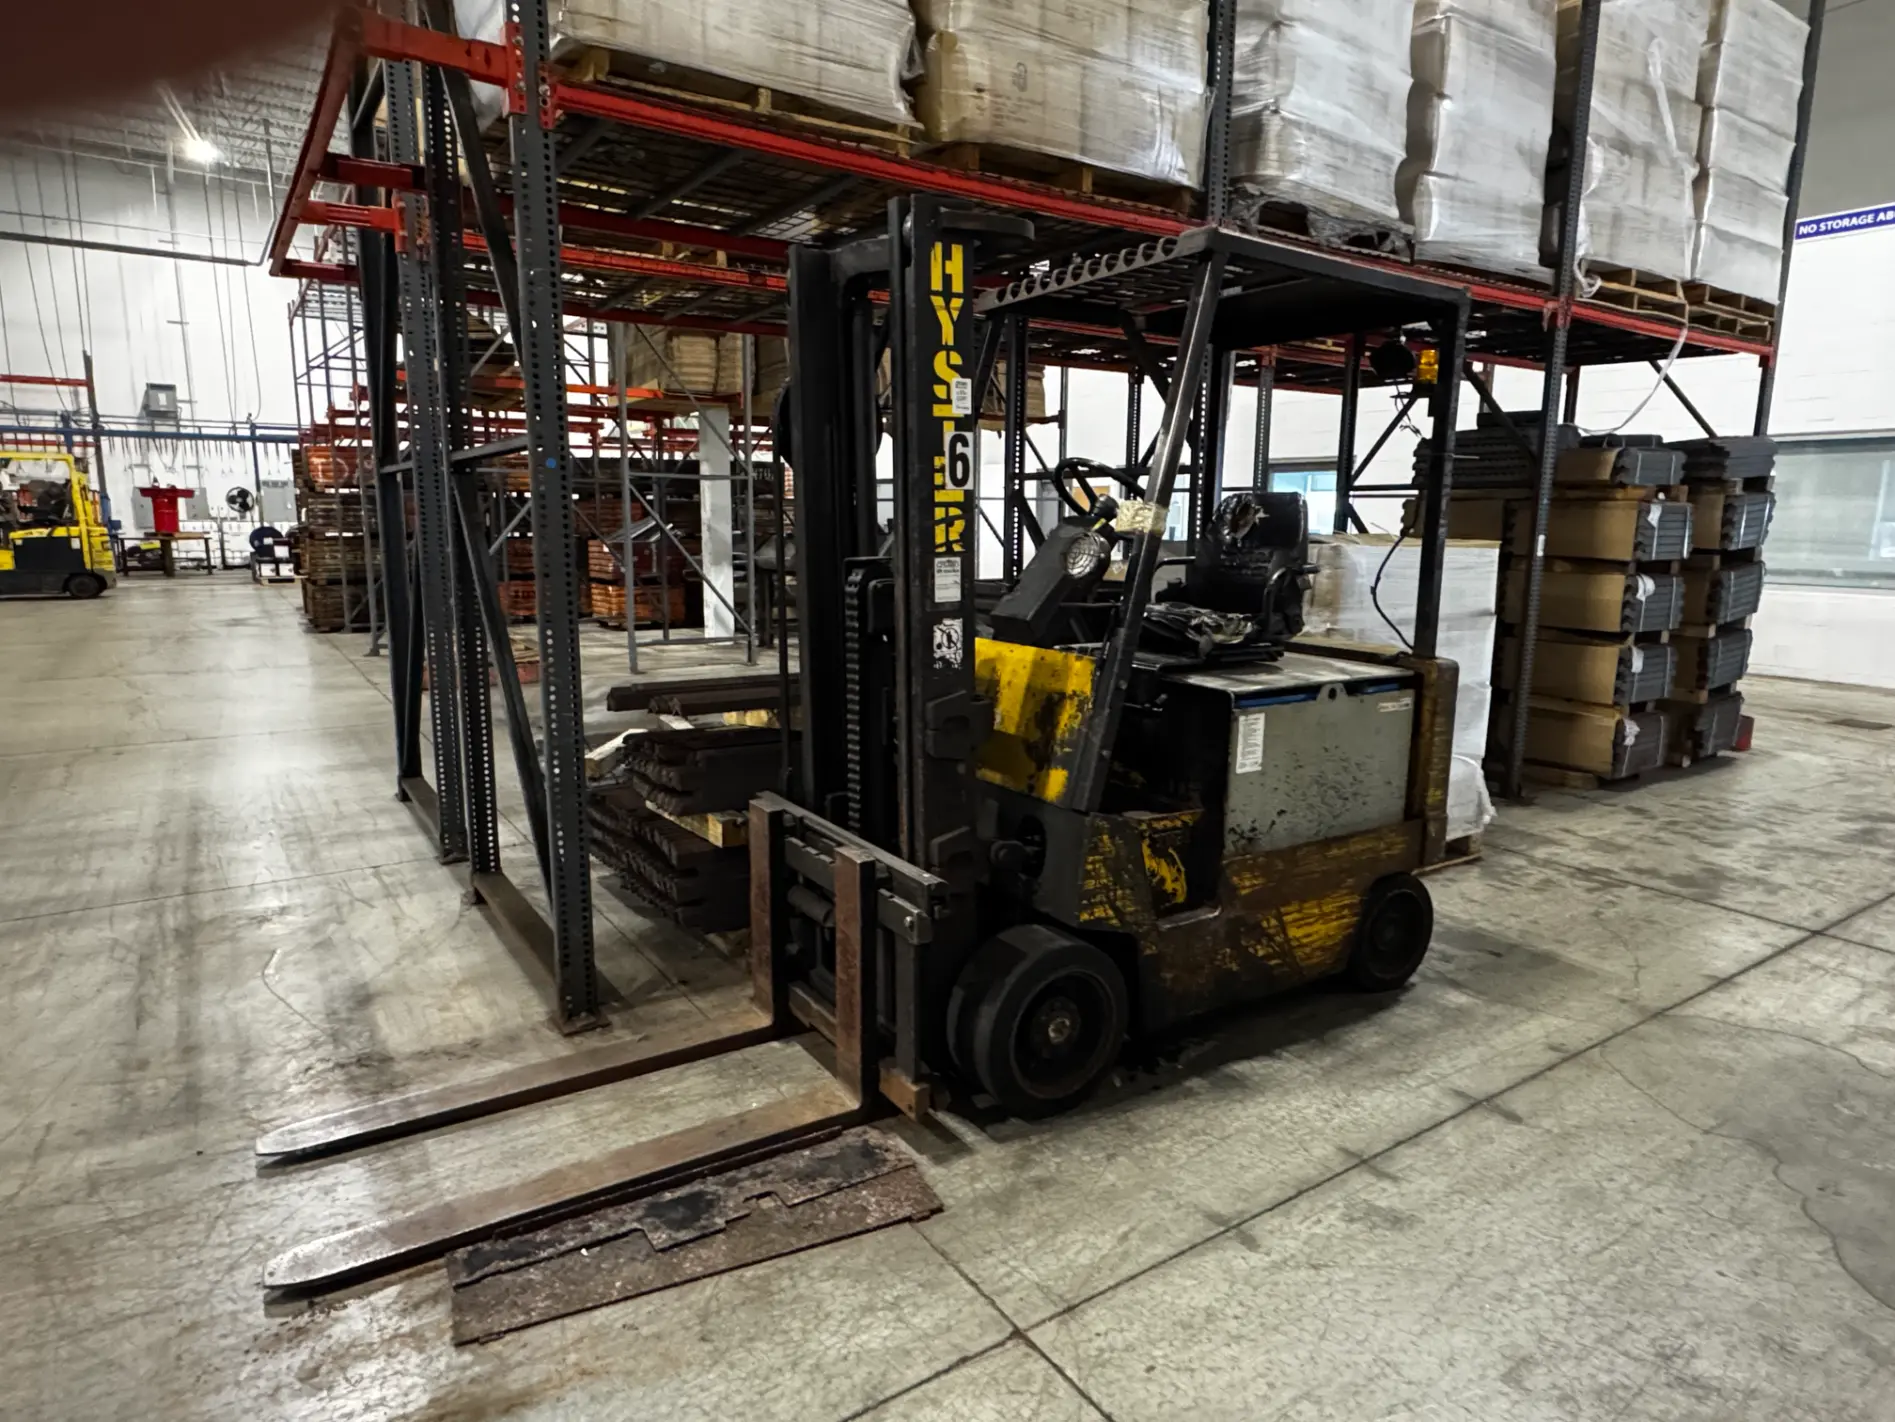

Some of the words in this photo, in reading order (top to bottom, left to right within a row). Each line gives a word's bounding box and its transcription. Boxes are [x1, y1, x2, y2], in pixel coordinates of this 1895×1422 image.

[1799, 224, 1817, 235] NO
[1819, 213, 1875, 231] STORAGE
[1876, 210, 1895, 222] AB
[949, 433, 970, 488] 6
